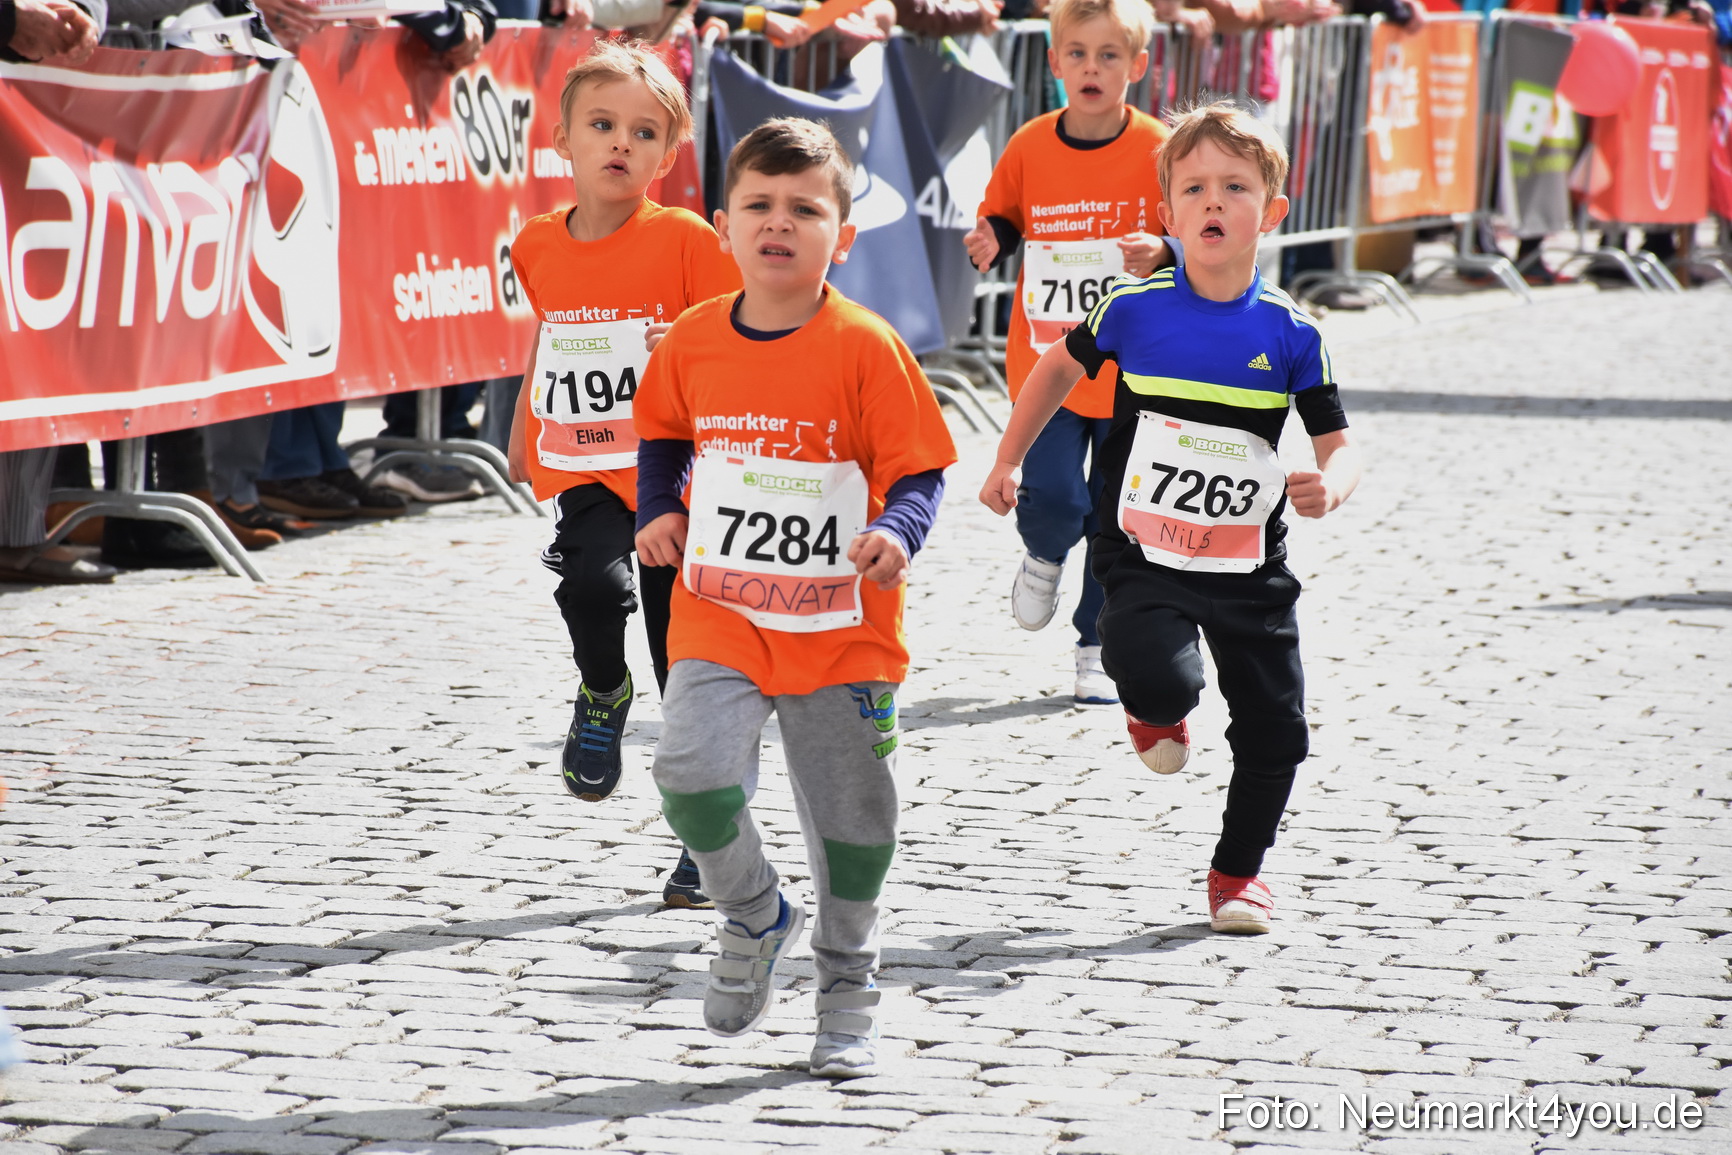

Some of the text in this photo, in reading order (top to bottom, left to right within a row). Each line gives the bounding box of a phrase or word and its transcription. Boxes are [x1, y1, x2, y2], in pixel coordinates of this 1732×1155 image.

[1031, 201, 1112, 218] Neumarkter
[1033, 217, 1095, 235] Stadtlauf
[1062, 252, 1103, 264] BOCK
[561, 337, 611, 351] BOCK
[546, 366, 638, 414] 7194
[576, 428, 615, 445] Eliah
[1194, 437, 1248, 457] BOCK
[760, 474, 823, 494] BOCK
[1150, 462, 1260, 518] 7263
[717, 506, 840, 566] 7284
[697, 567, 851, 612] LEONAT
[587, 708, 609, 719] LICO
